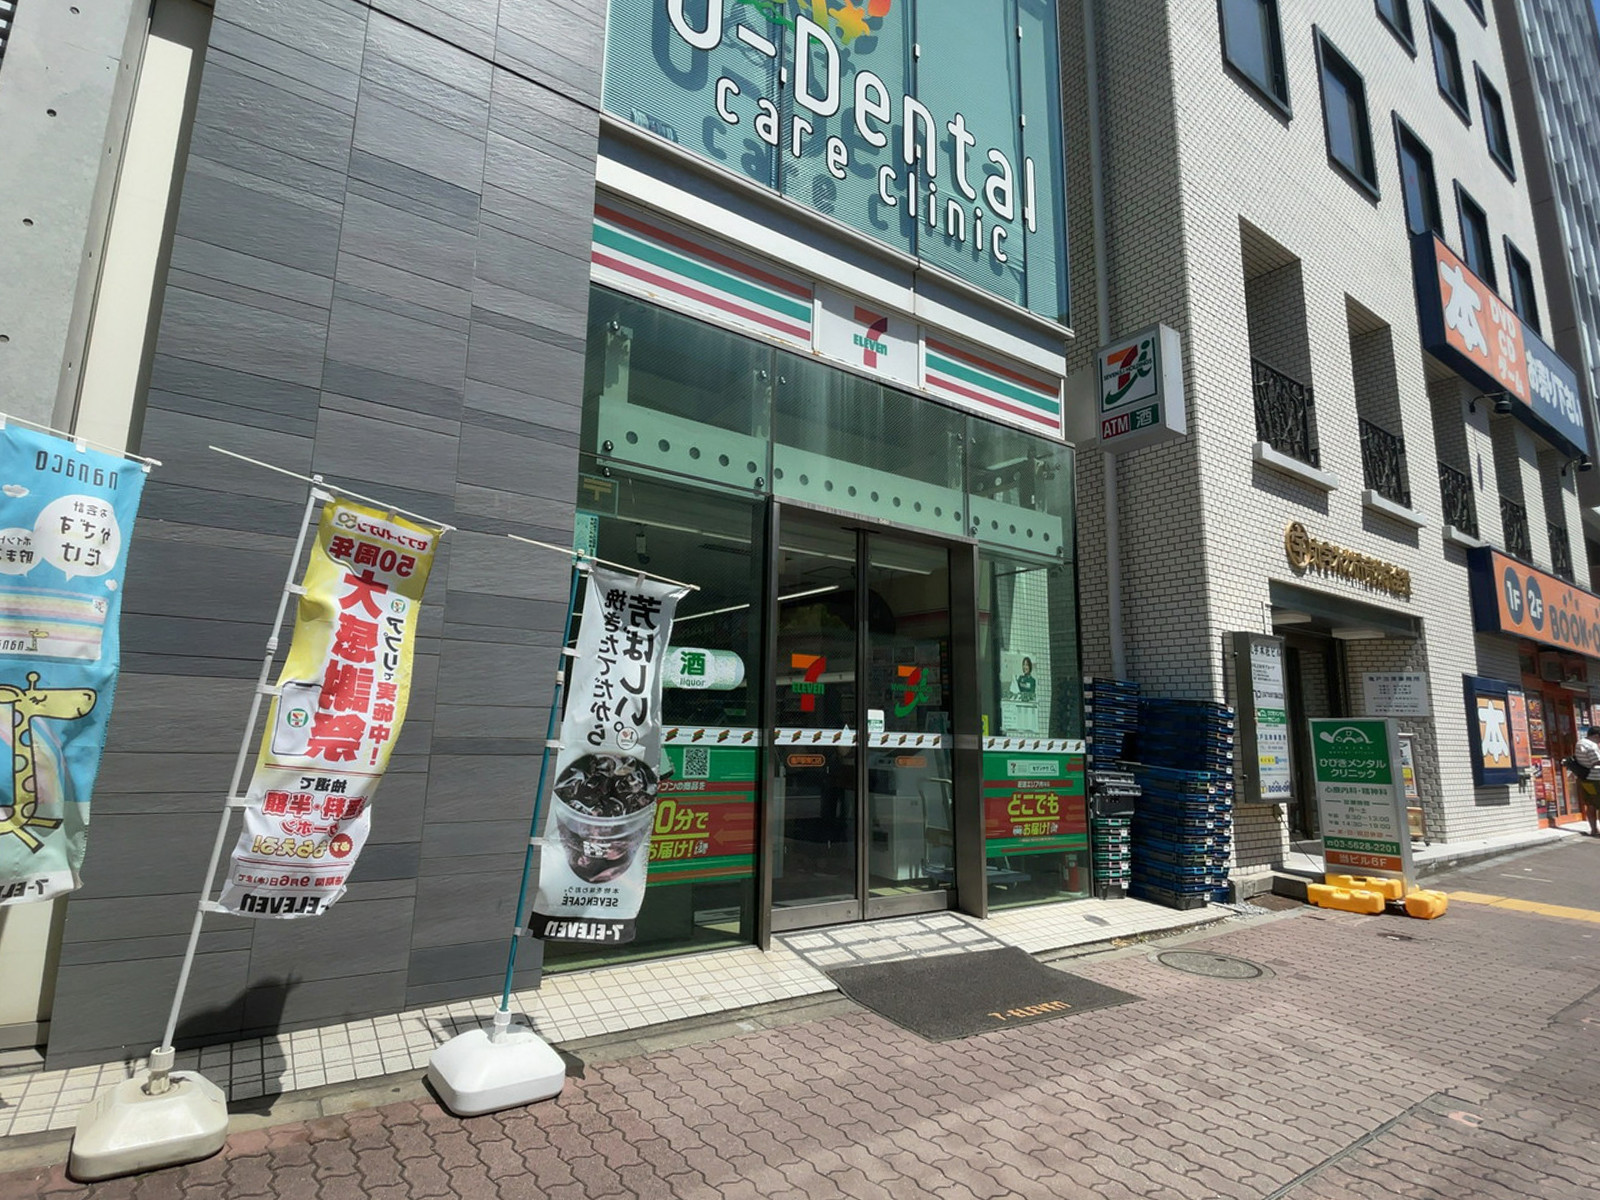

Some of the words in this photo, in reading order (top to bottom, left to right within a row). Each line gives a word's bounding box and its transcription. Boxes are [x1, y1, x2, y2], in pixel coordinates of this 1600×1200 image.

[715, 77, 849, 179] care
[878, 165, 1008, 263] clinic
[1440, 261, 1488, 358] 本
[1489, 295, 1516, 338] DVD
[1498, 328, 1516, 363] CD
[1497, 354, 1525, 397] ゲーム
[1104, 416, 1129, 438] ATM
[1136, 407, 1153, 428] 酒
[1506, 580, 1521, 612] 1F
[1528, 589, 1543, 620] 2F
[680, 651, 706, 677] 酒
[680, 678, 706, 688] liquor
[1478, 700, 1509, 763] 本
[1320, 758, 1387, 769] ひびきメンタル
[1330, 769, 1376, 779] クリニック
[1007, 793, 1059, 815] どこでも
[1333, 840, 1397, 853] 03-5628-2201
[1339, 854, 1387, 867] 当ビル6F
